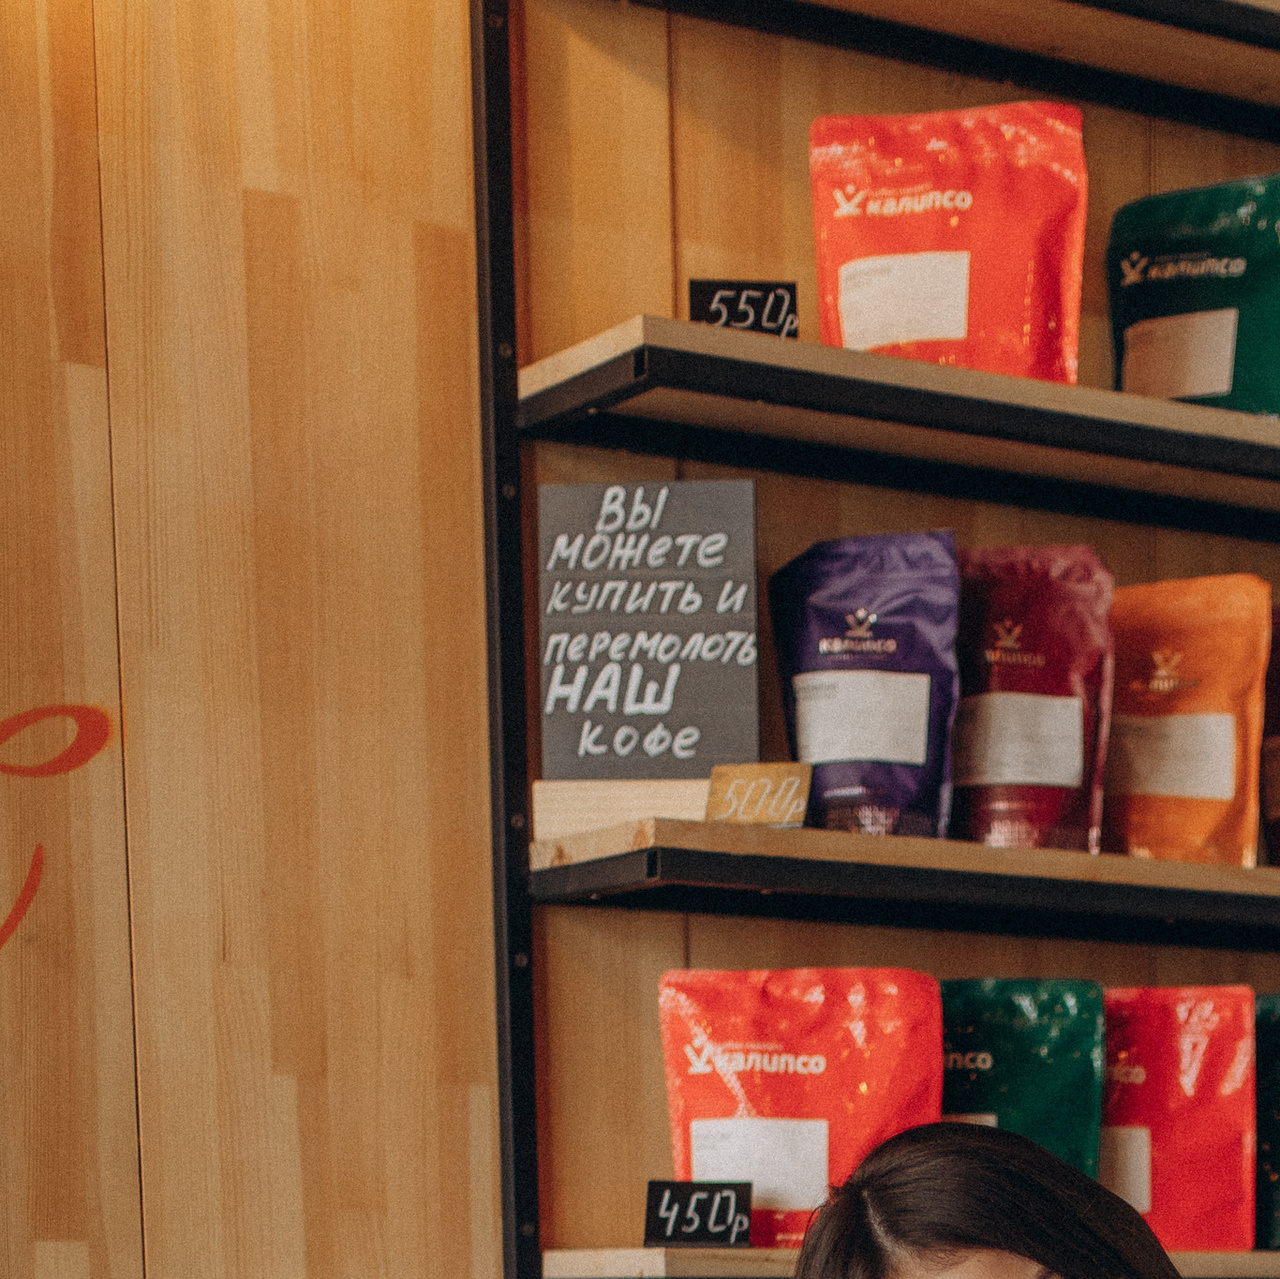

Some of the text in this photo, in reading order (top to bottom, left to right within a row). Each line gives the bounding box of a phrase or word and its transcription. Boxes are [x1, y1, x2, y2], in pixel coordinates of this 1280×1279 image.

[595, 485, 669, 533] ВЫ
[546, 579, 749, 615] КУПИТЬ И
[544, 662, 682, 716] НАШ
[658, 1188, 750, 1245] 450р
